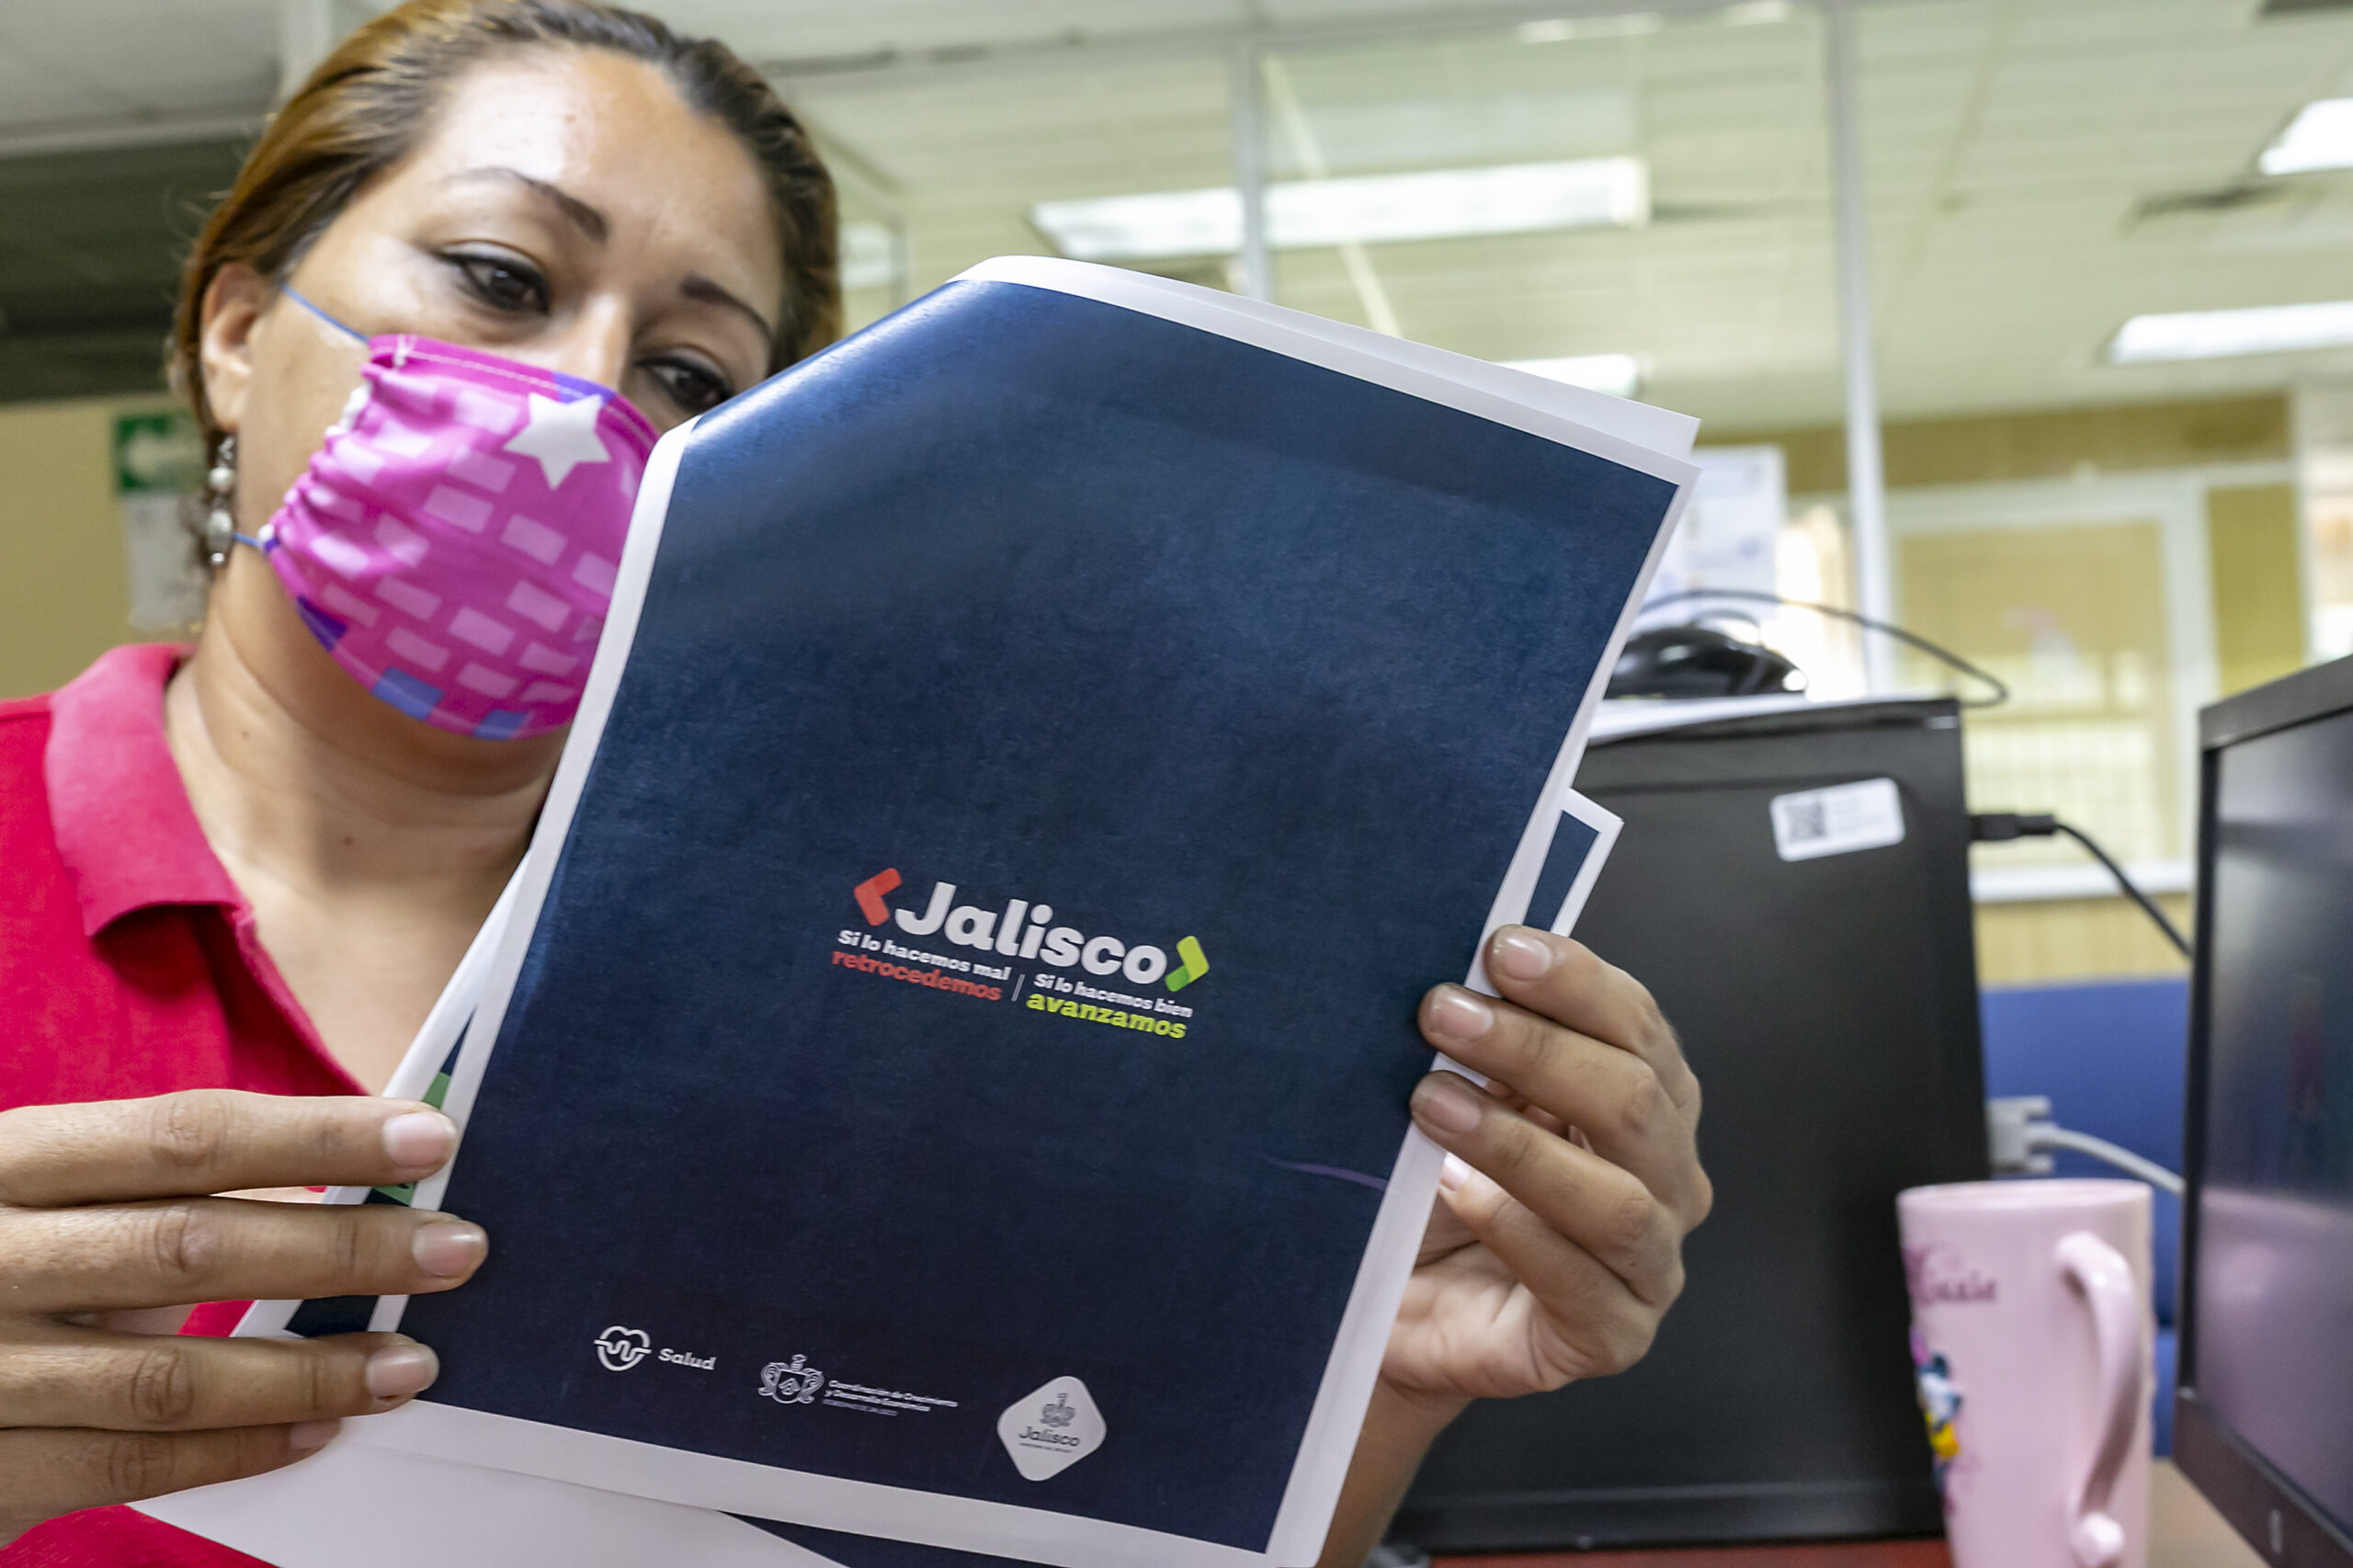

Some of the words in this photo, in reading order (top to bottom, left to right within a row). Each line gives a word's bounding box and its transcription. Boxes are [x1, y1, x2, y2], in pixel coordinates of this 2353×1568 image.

[837, 929, 862, 947] Si
[860, 934, 881, 951] lo
[882, 939, 971, 972] hacemos
[972, 965, 1012, 981] mal
[895, 881, 1167, 984] Jalisco
[831, 950, 1003, 1002] retrocedemos
[1033, 972, 1056, 989] Si
[1054, 977, 1074, 994] lo
[1074, 981, 1154, 1010] hacemos
[1154, 998, 1194, 1018] bien
[1026, 993, 1188, 1039] avanzamos
[658, 1347, 717, 1370] Salud
[1018, 1426, 1080, 1447] Jalisco
